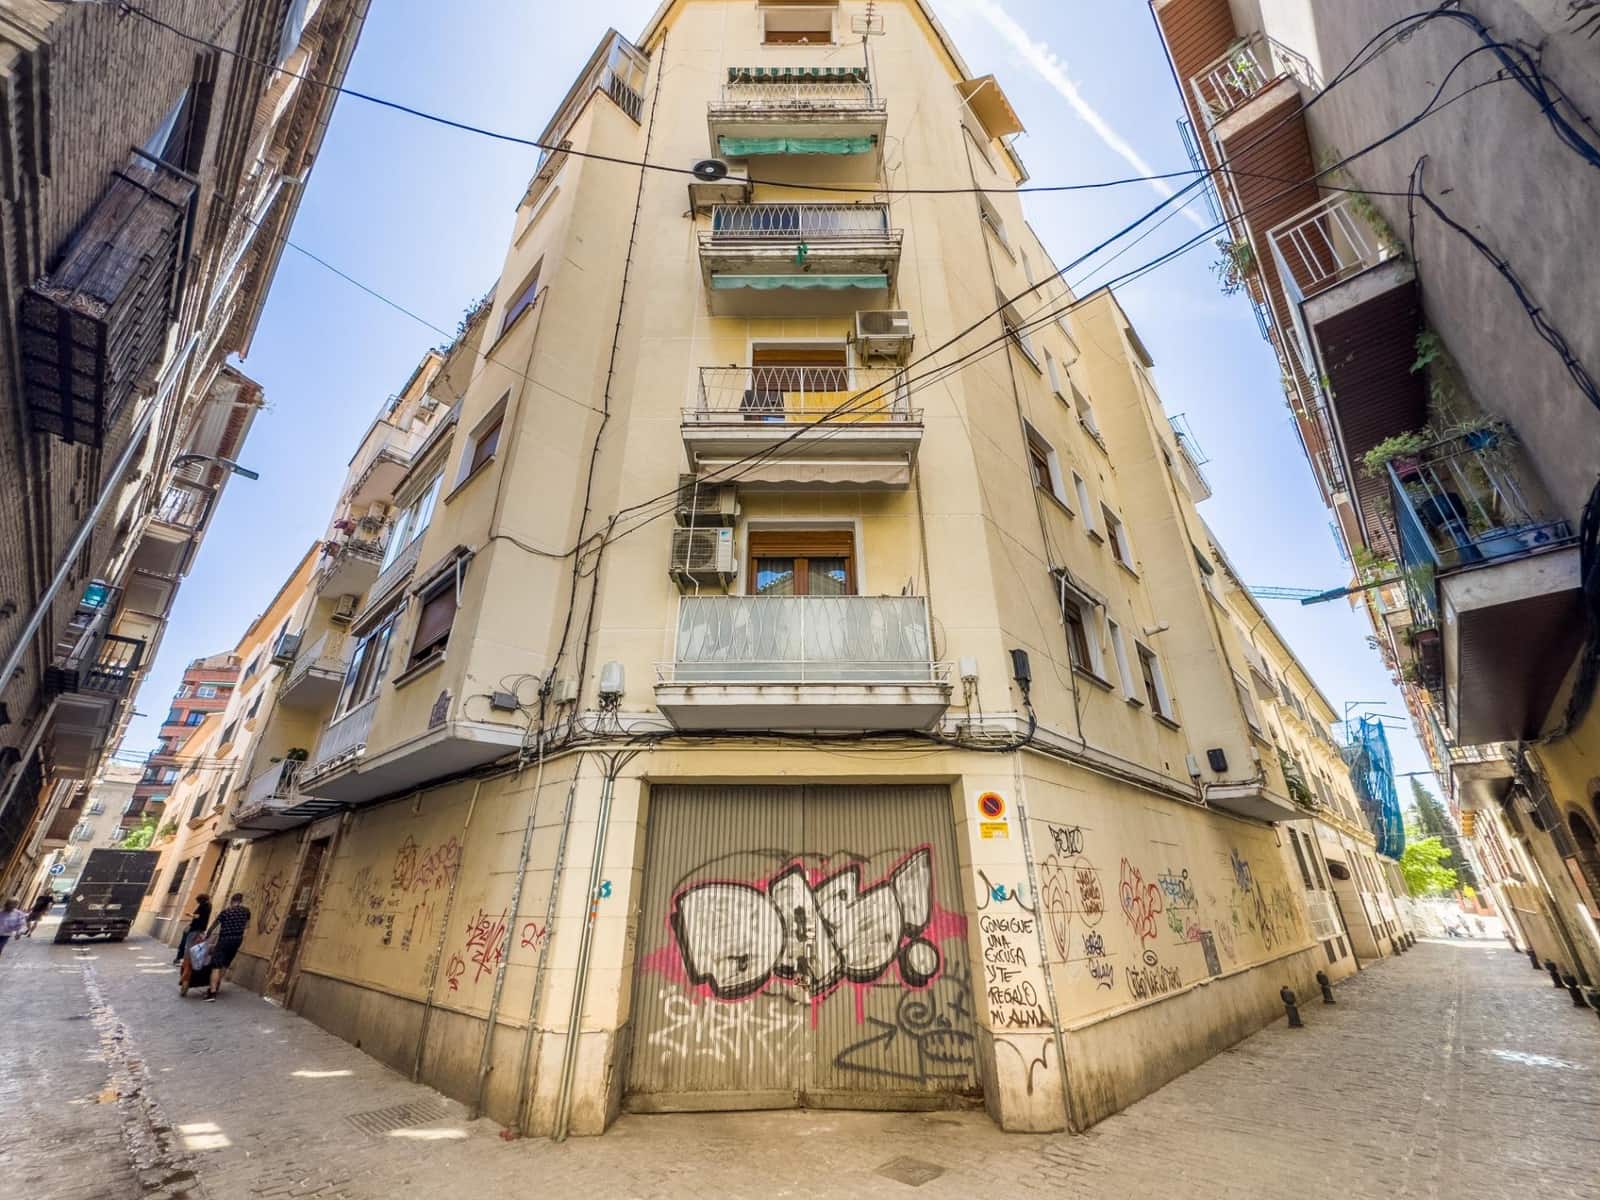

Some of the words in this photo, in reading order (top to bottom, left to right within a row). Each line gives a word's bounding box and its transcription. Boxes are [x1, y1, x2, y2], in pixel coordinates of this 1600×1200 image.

[980, 916, 1033, 934] CONSIGUE
[988, 935, 1011, 949] UNA
[985, 948, 1027, 966] EXCUSA
[997, 967, 1022, 983] TE
[988, 981, 1037, 1007] REGALO
